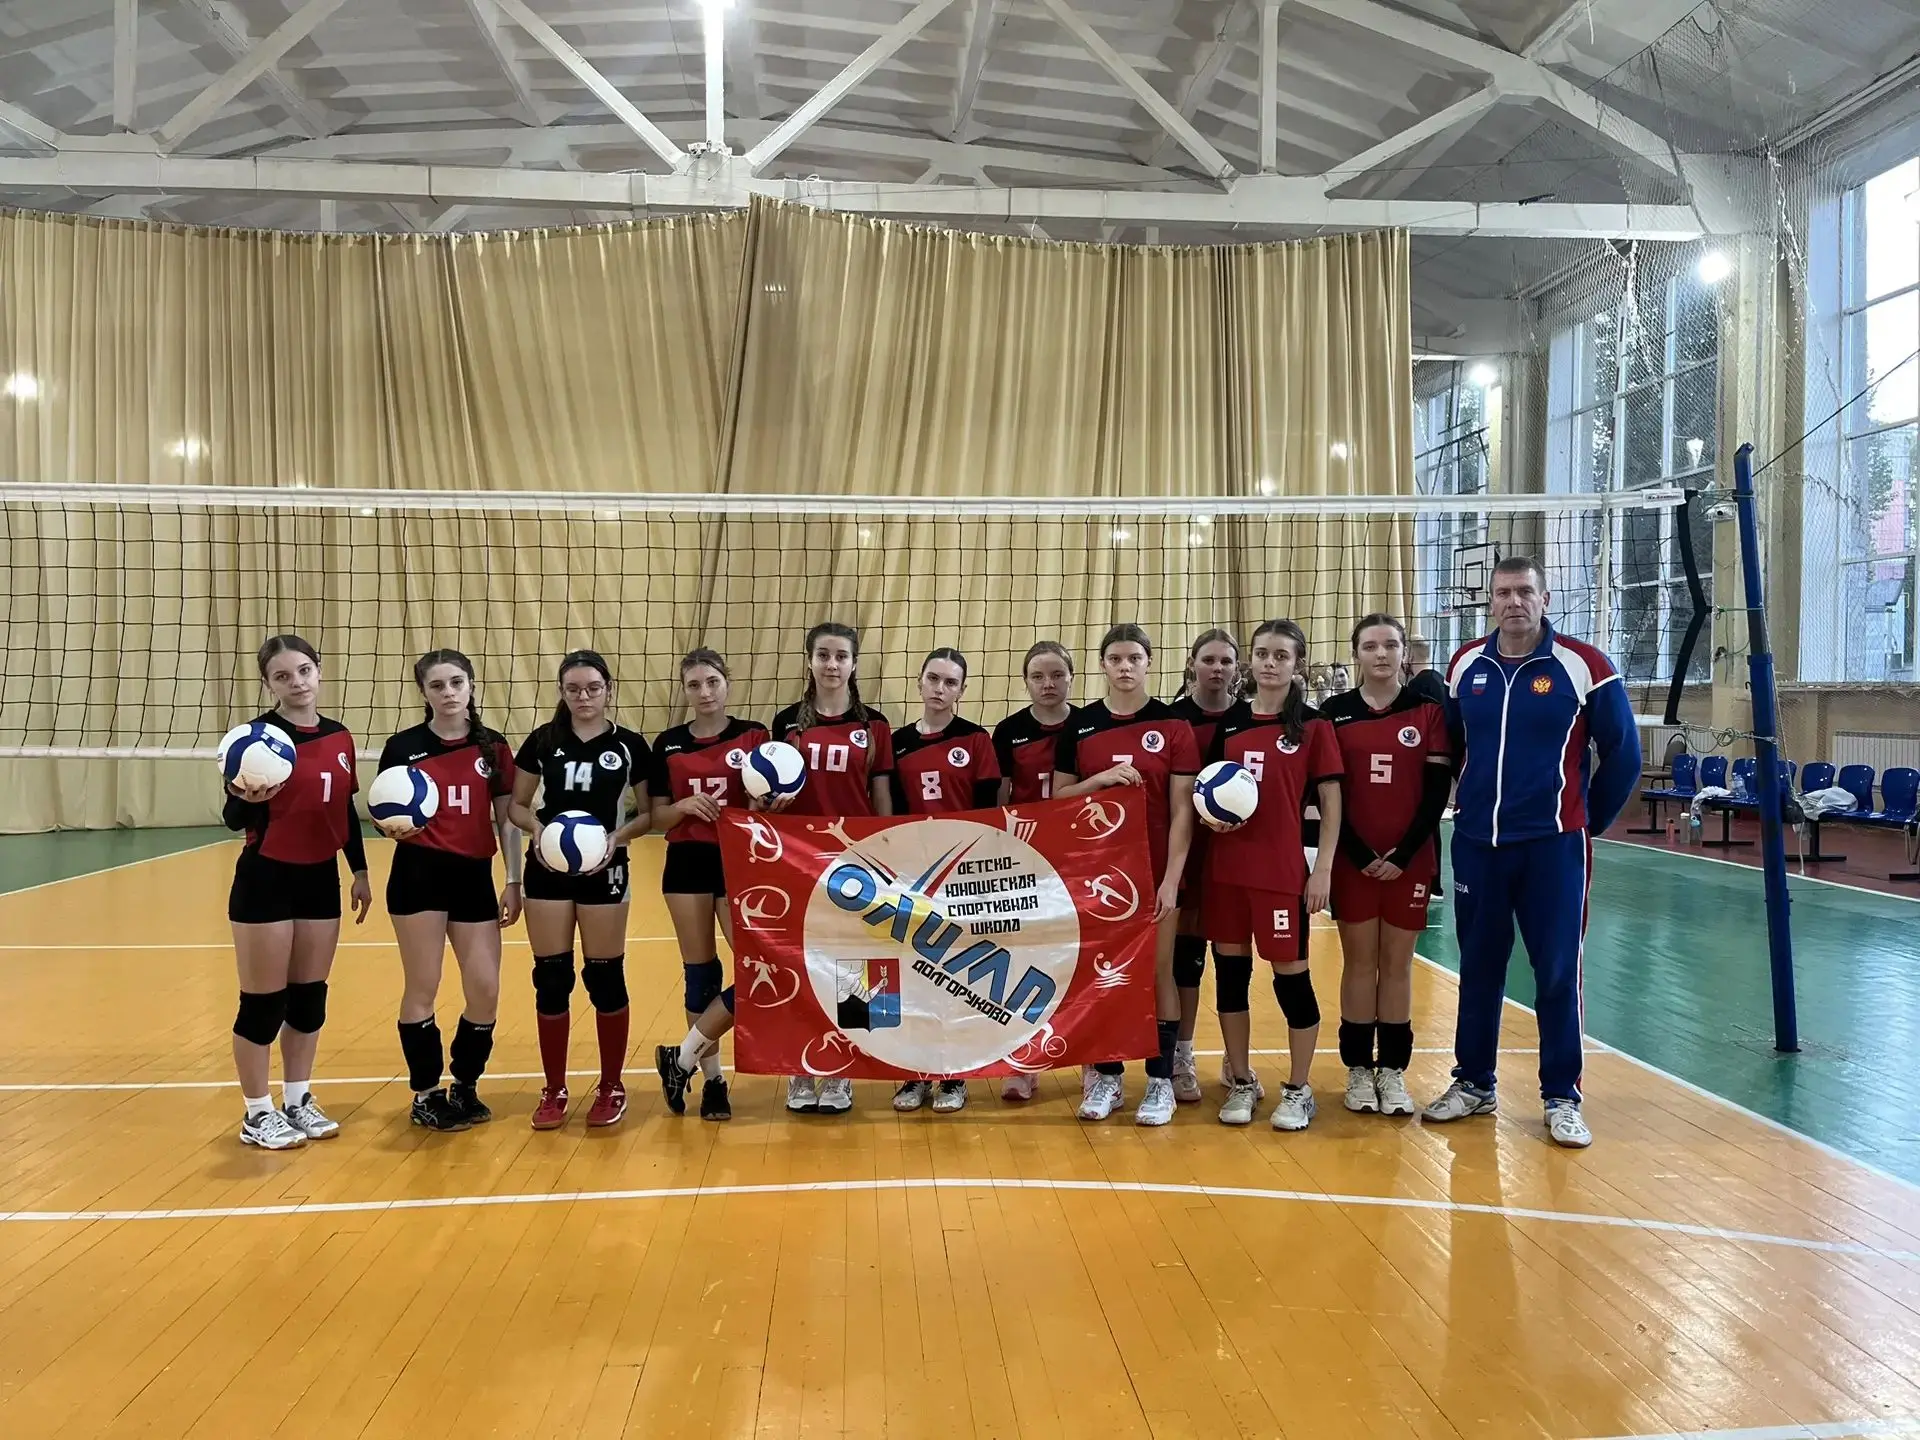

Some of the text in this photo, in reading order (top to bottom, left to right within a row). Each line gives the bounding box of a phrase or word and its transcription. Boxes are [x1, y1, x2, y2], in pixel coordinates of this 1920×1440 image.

[807, 742, 850, 773] 10
[1243, 750, 1265, 782] 6
[1370, 753, 1393, 784] 5
[320, 771, 332, 803] 1
[563, 761, 594, 792] 14
[688, 776, 728, 806] 12
[920, 770, 943, 801] 8
[447, 785, 470, 815] 4
[607, 865, 624, 885] 14
[957, 856, 1021, 876] ДЕТСКО-
[945, 873, 1037, 898] ЮНОШЕСКАЯ
[947, 895, 1039, 917] СПОРТИВНАЯ
[1273, 909, 1290, 931] 6
[970, 918, 1021, 936] ШКОЛА
[911, 959, 1013, 1026] ДОЛГОРУКОВО
